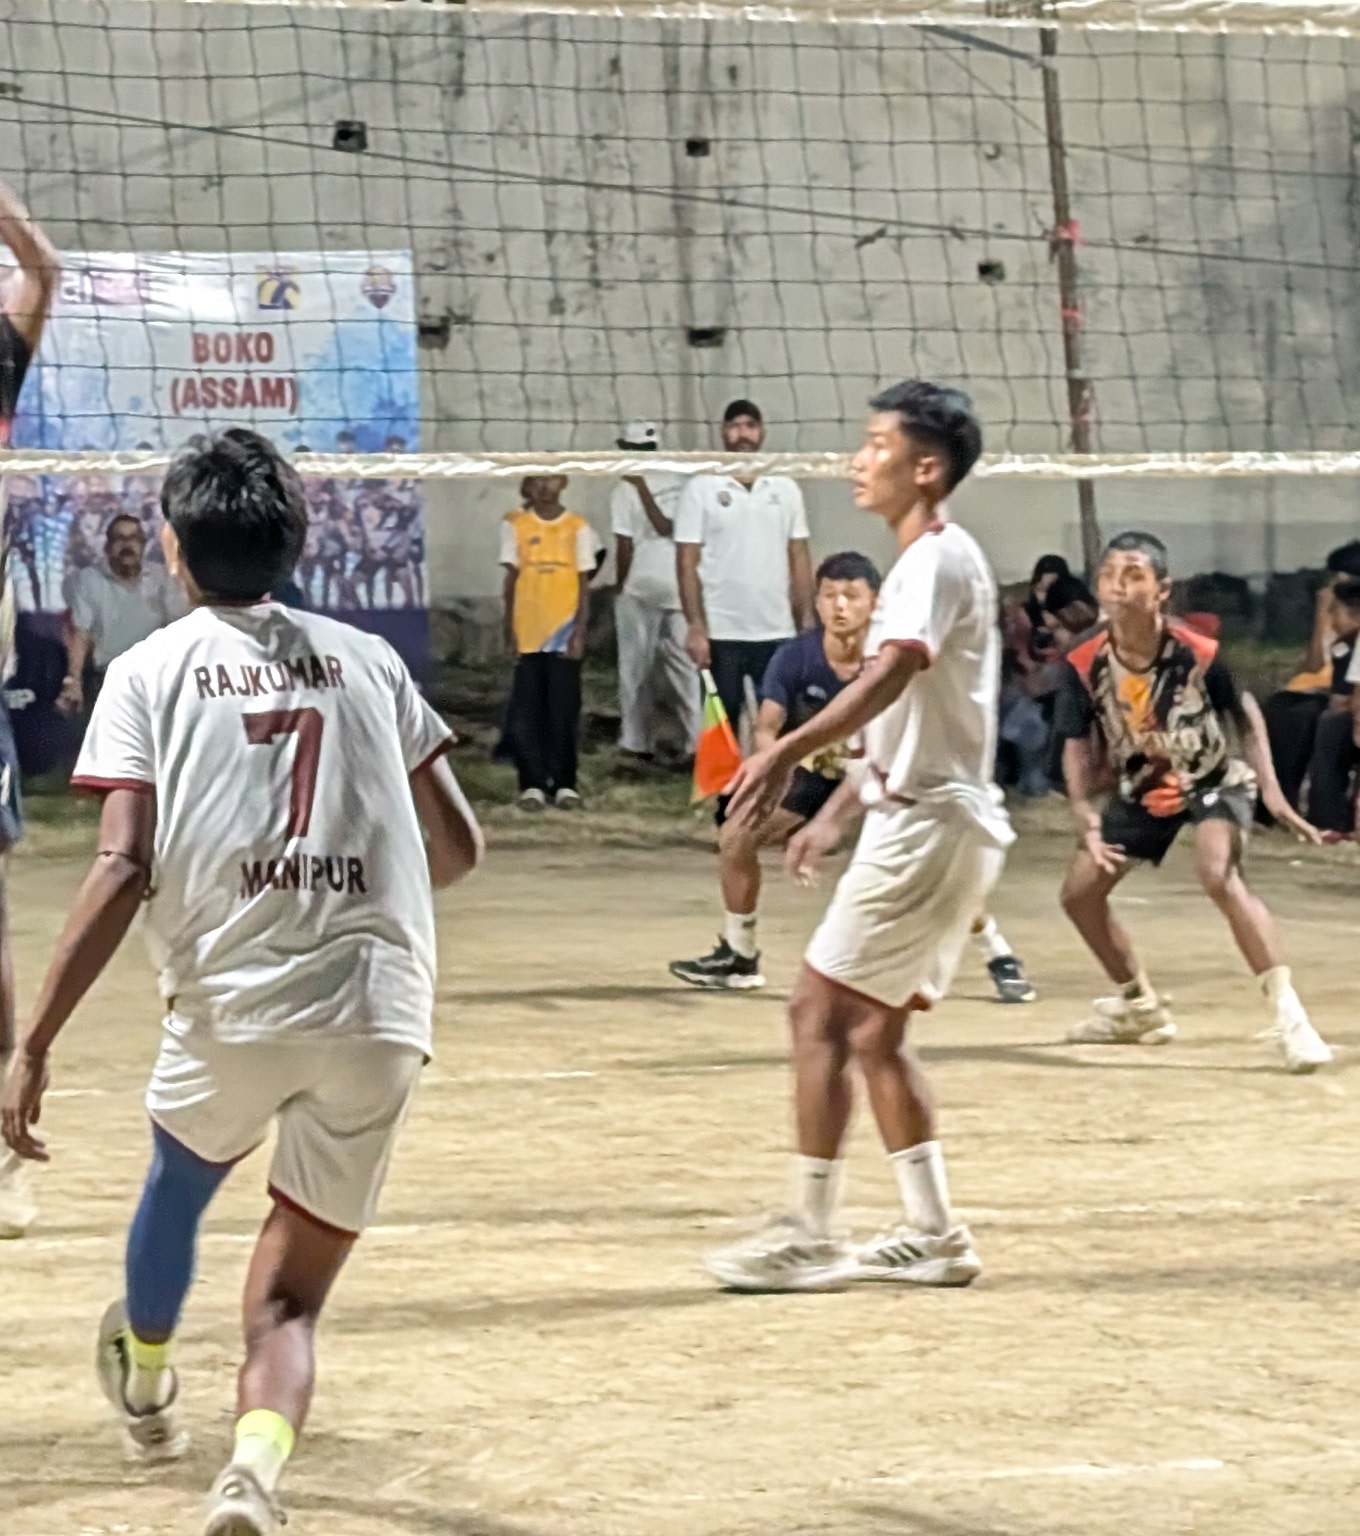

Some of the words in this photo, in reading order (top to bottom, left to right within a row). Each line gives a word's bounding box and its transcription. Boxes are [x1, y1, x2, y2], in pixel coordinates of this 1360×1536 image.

[191, 331, 275, 364] BOKO
[170, 375, 300, 415] (ASSAM)
[194, 654, 346, 699] RAJKUMAR
[243, 707, 324, 838] 7
[240, 855, 367, 900] MANIPUR
